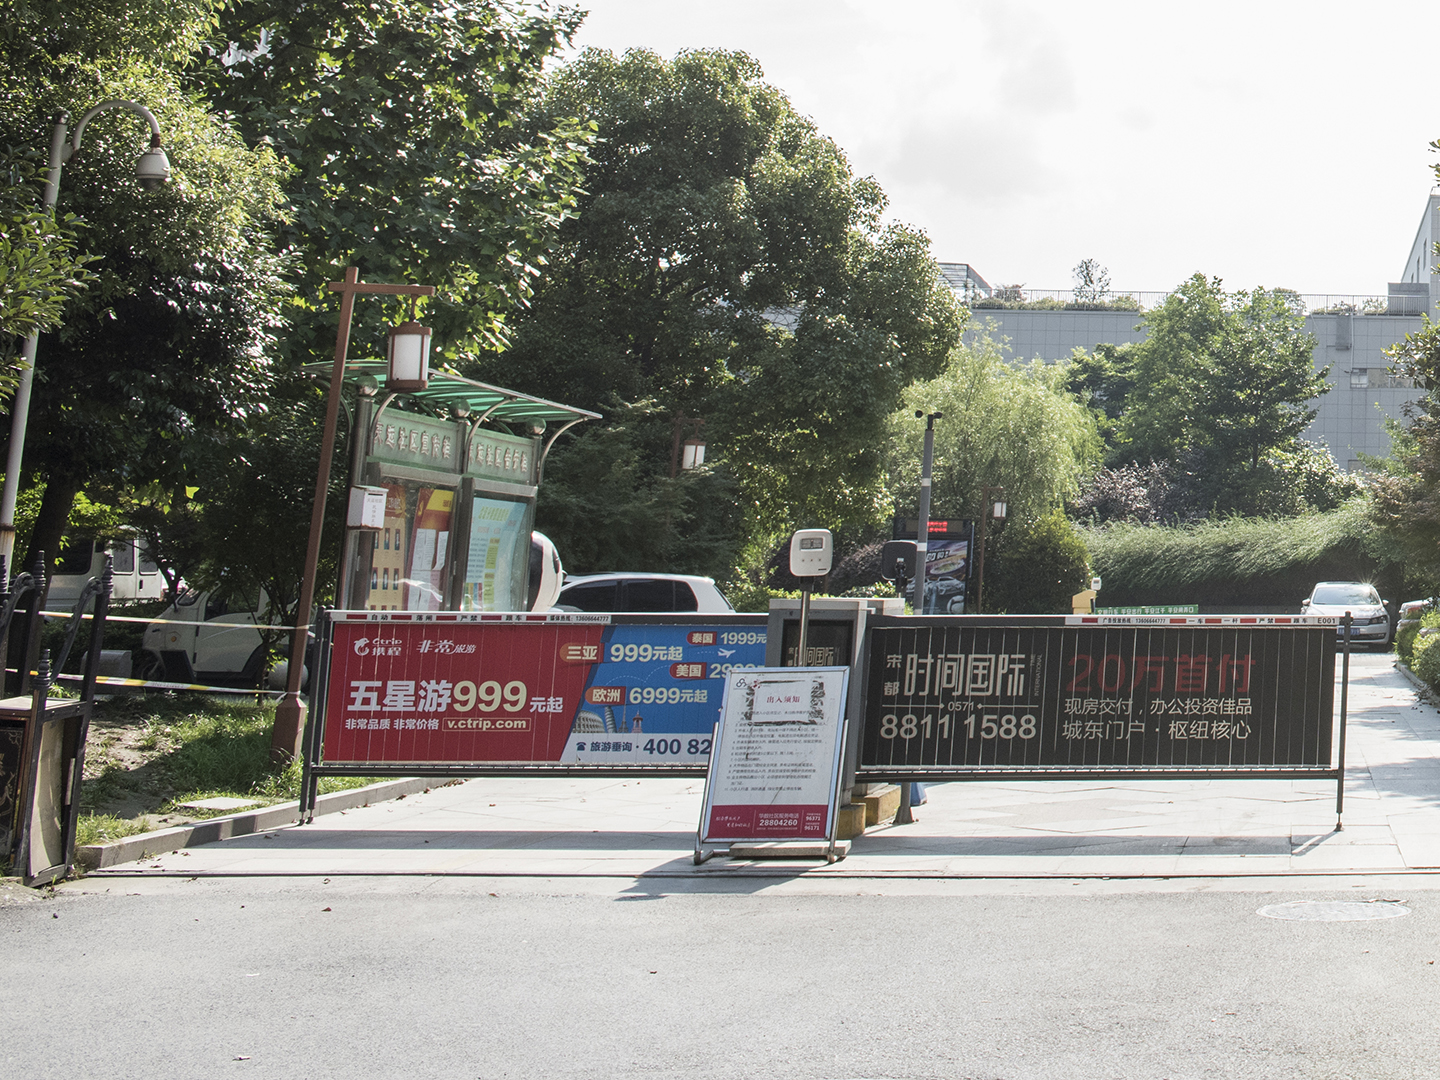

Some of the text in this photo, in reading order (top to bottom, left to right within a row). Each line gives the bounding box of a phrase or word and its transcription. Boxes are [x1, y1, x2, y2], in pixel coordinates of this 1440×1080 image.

[372, 637, 402, 646] Ctrip
[692, 631, 767, 645] 泰国 1999元
[372, 647, 401, 656] 携程
[416, 639, 477, 654] 非常旅游
[566, 644, 683, 662] 三亚 999元起
[676, 664, 702, 678] 美国
[883, 654, 902, 696] 宋都
[904, 654, 1025, 696] 时间国际
[1066, 654, 1256, 693] 20万首付
[347, 680, 563, 713] 五星游999元起
[592, 687, 708, 704] 欧洲 6999元起
[766, 696, 800, 704] 出入须知
[947, 702, 974, 711] 0571
[345, 719, 527, 730] 非常品质 非常价格 v.ctrip.com
[880, 714, 1037, 739] 8811 1588
[643, 739, 682, 755] 400
[687, 739, 711, 755] 82
